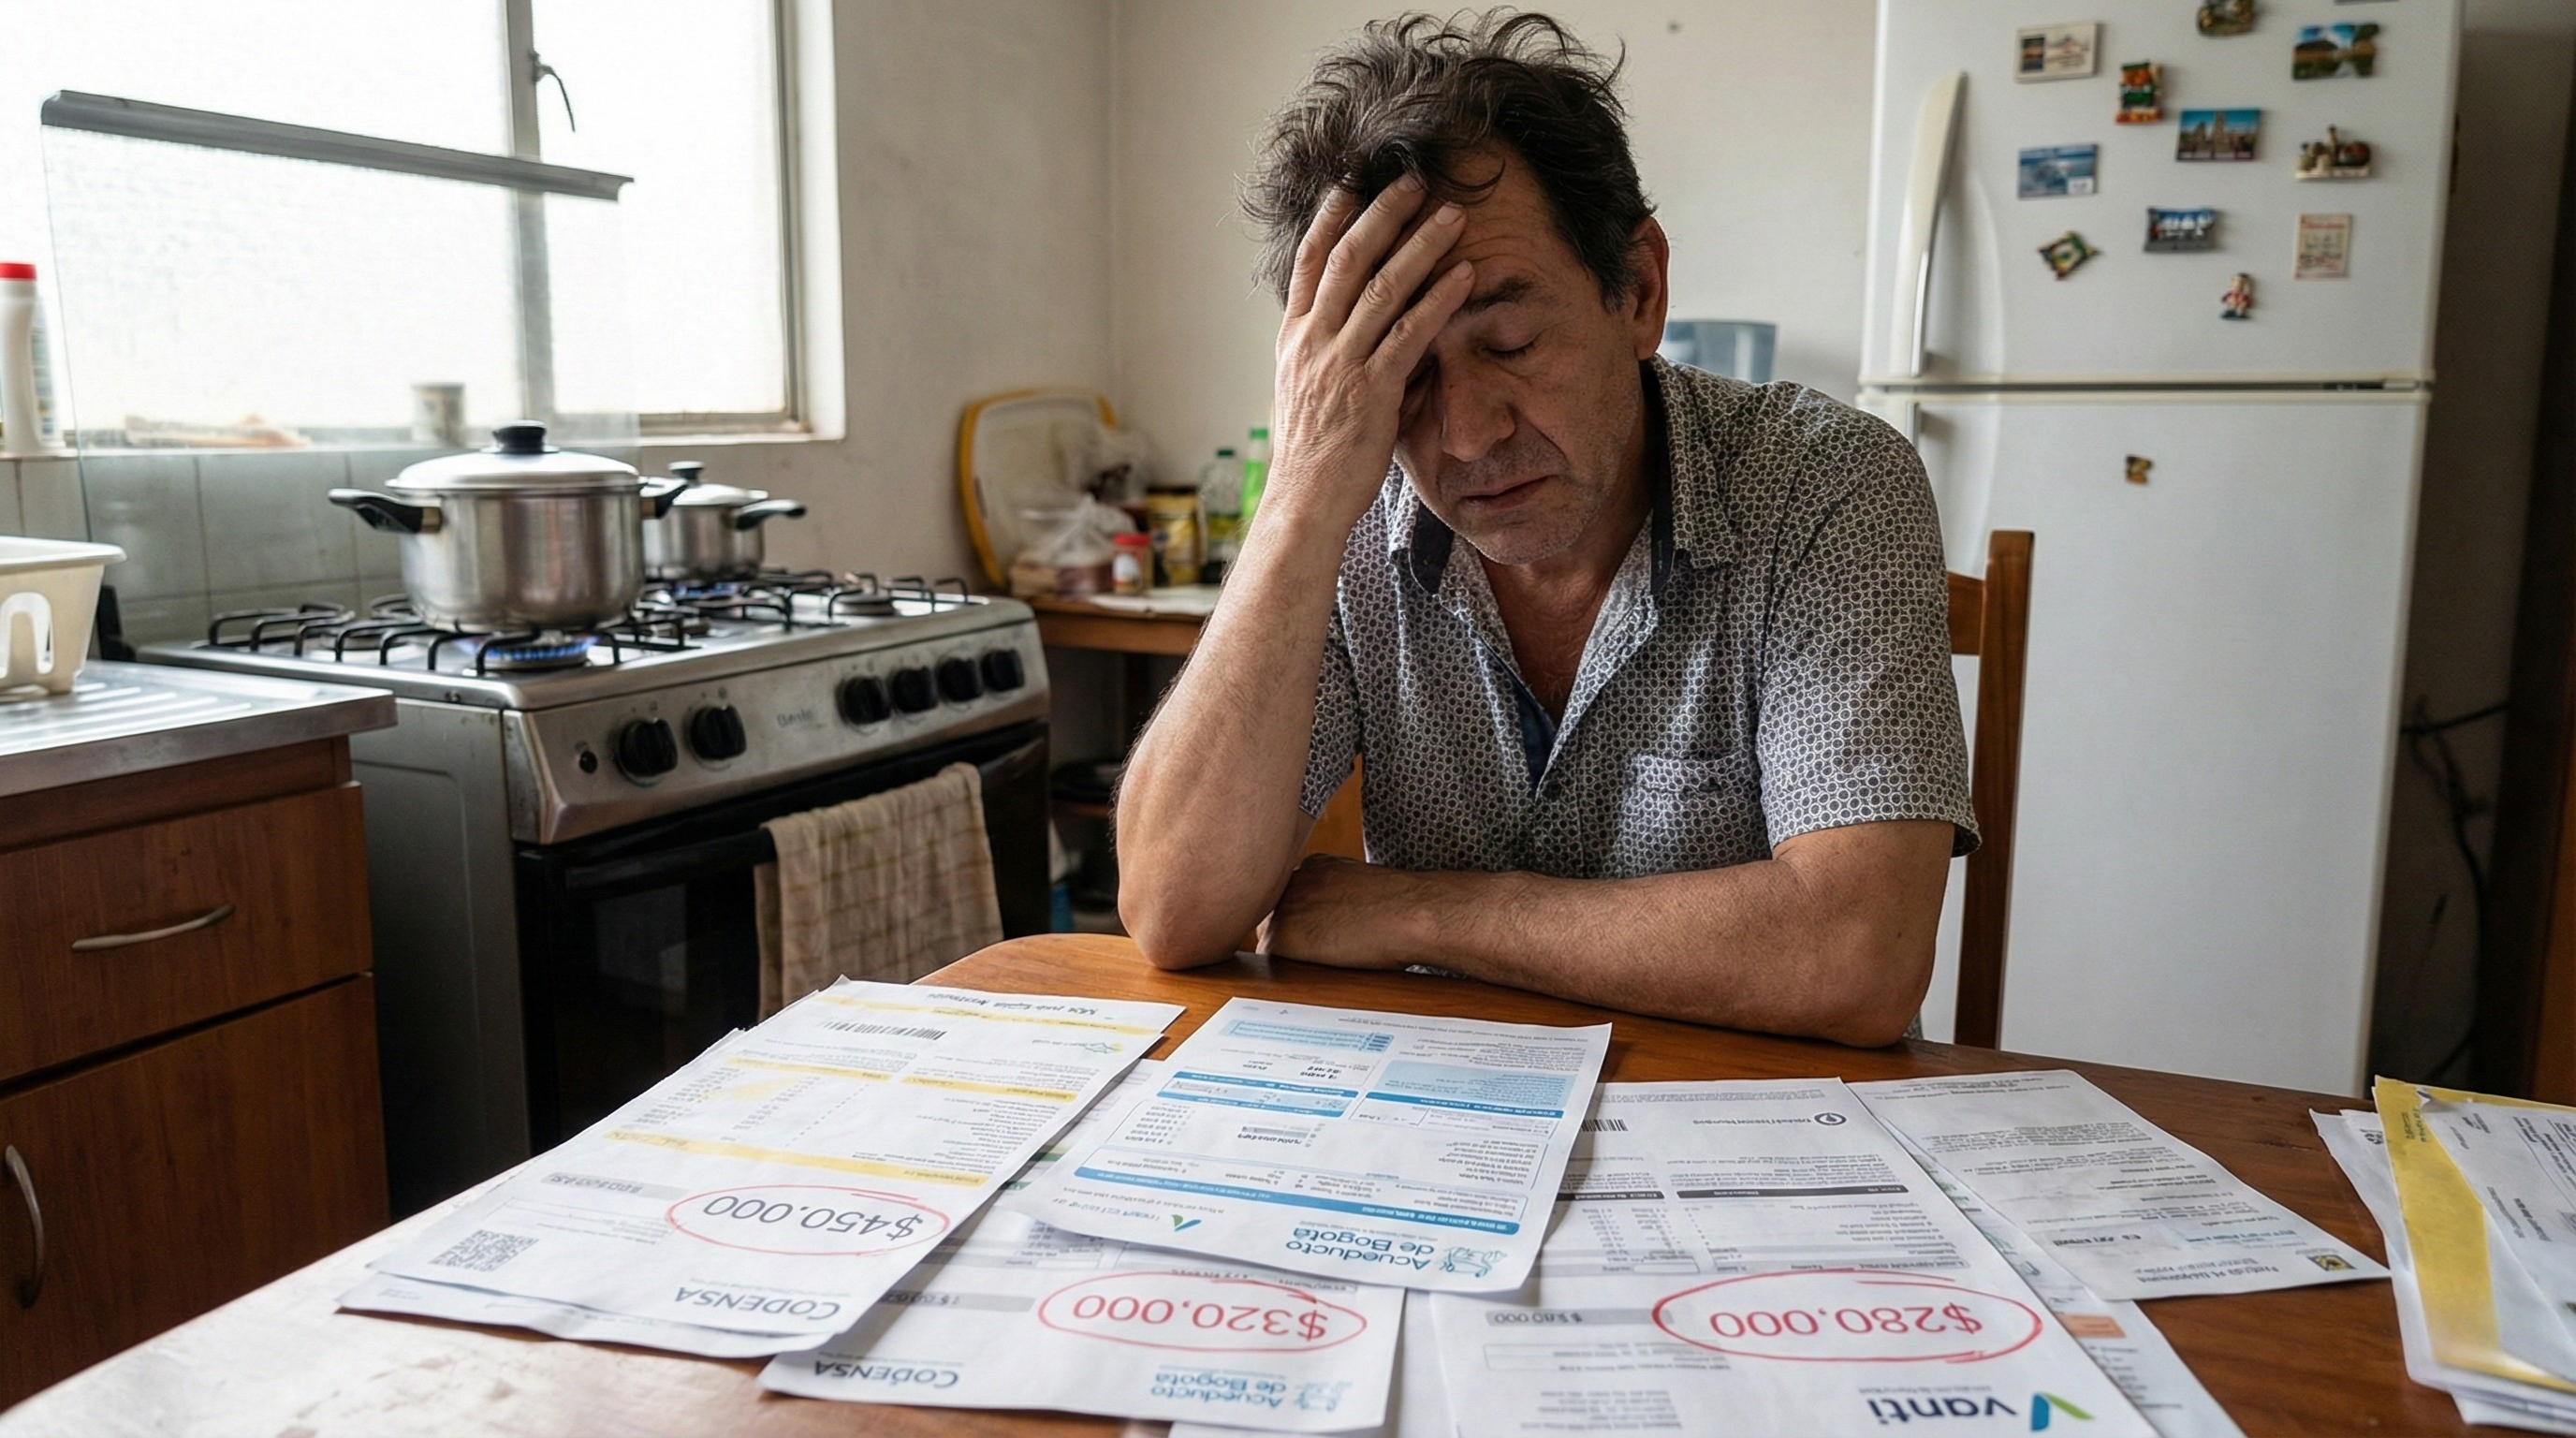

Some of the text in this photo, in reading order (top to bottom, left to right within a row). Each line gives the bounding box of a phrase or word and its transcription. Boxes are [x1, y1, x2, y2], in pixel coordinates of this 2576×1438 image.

[703, 1196, 923, 1240] $450.000
[1709, 1302, 1983, 1338] $280,000
[1867, 1396, 2017, 1425] vanti
